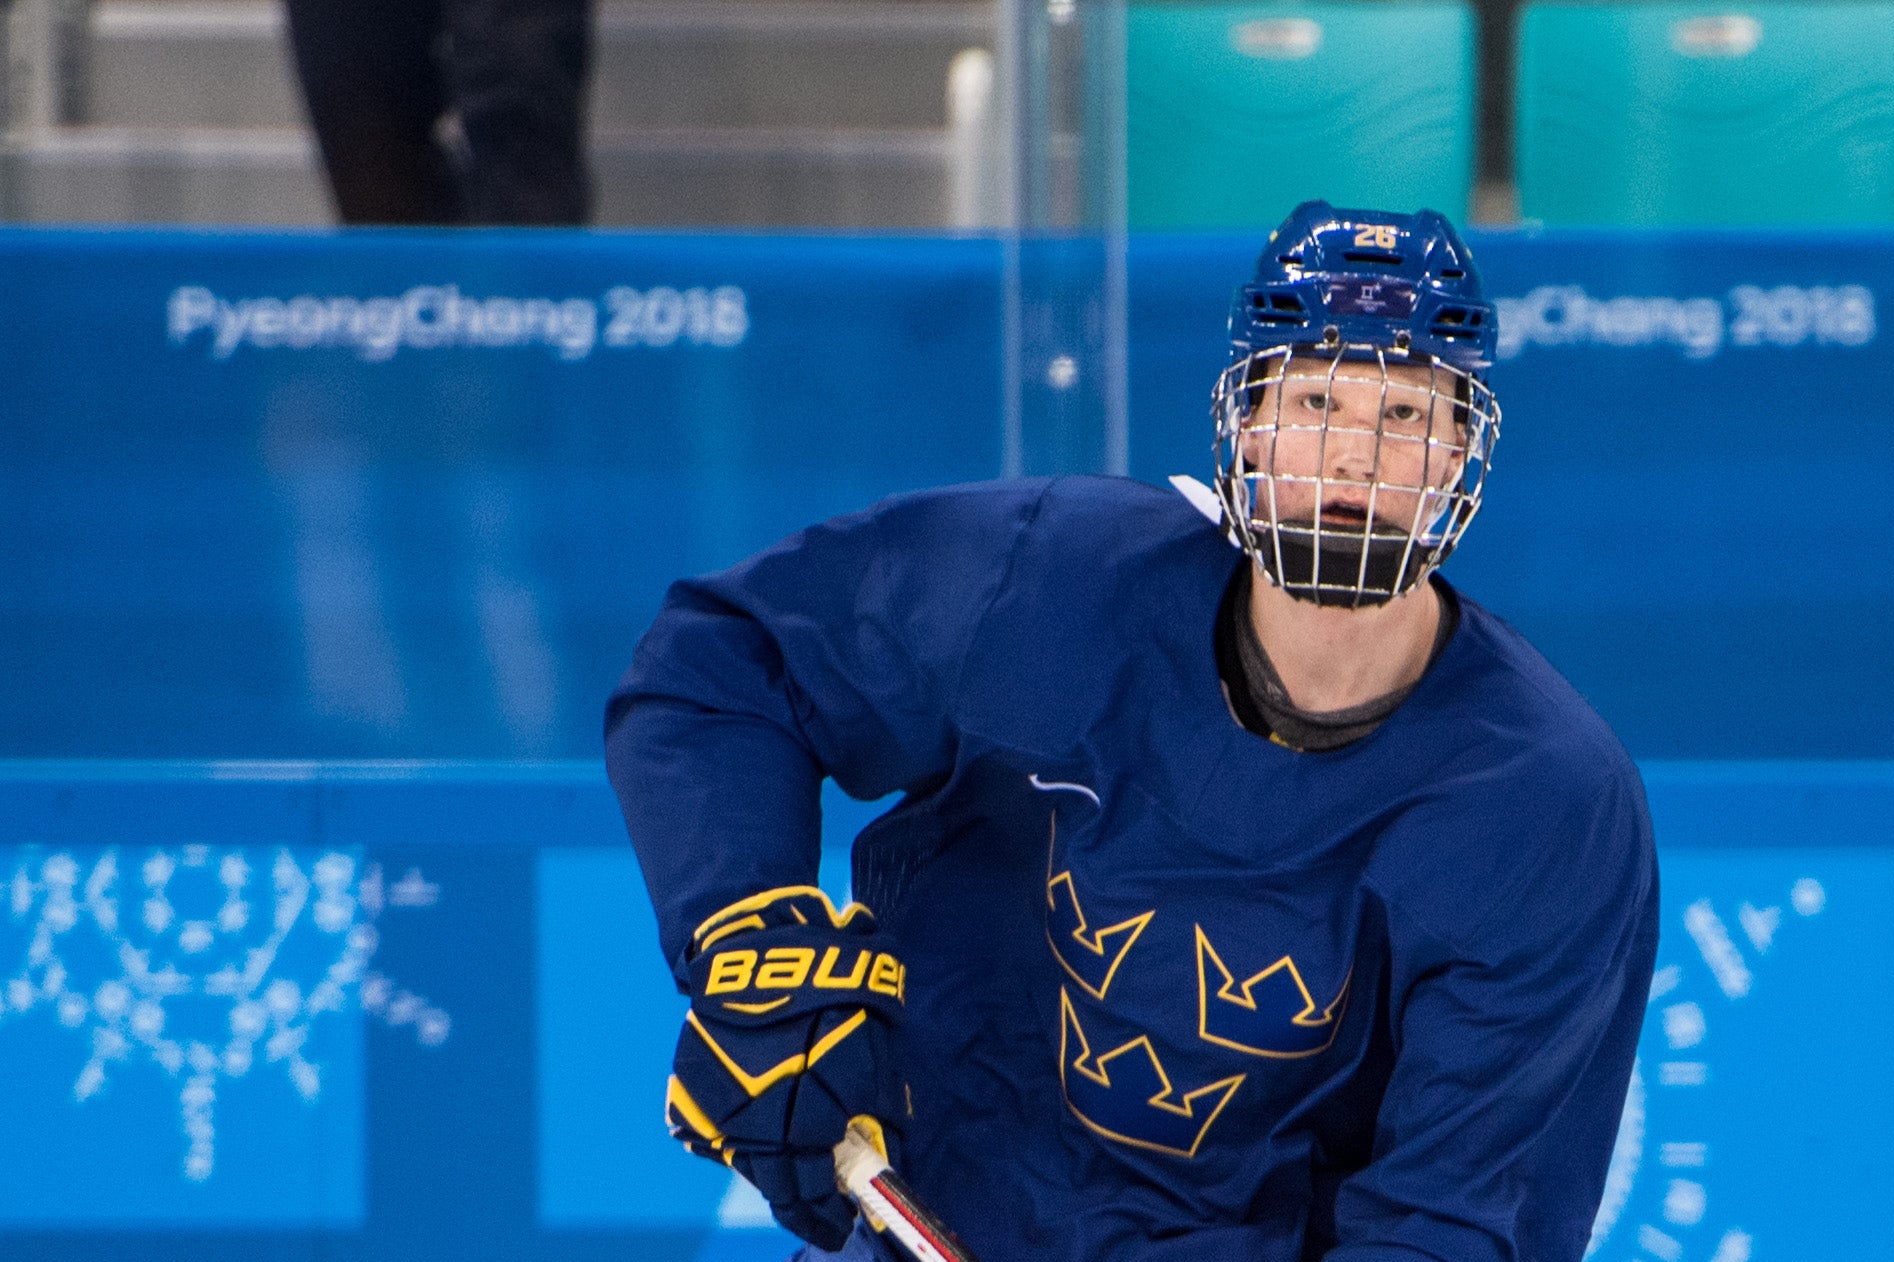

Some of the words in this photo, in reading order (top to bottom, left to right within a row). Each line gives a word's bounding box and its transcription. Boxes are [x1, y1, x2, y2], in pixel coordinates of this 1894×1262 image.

[168, 285, 598, 360] PyeongChang
[604, 285, 749, 346] 2018
[1729, 284, 1875, 345] 2018
